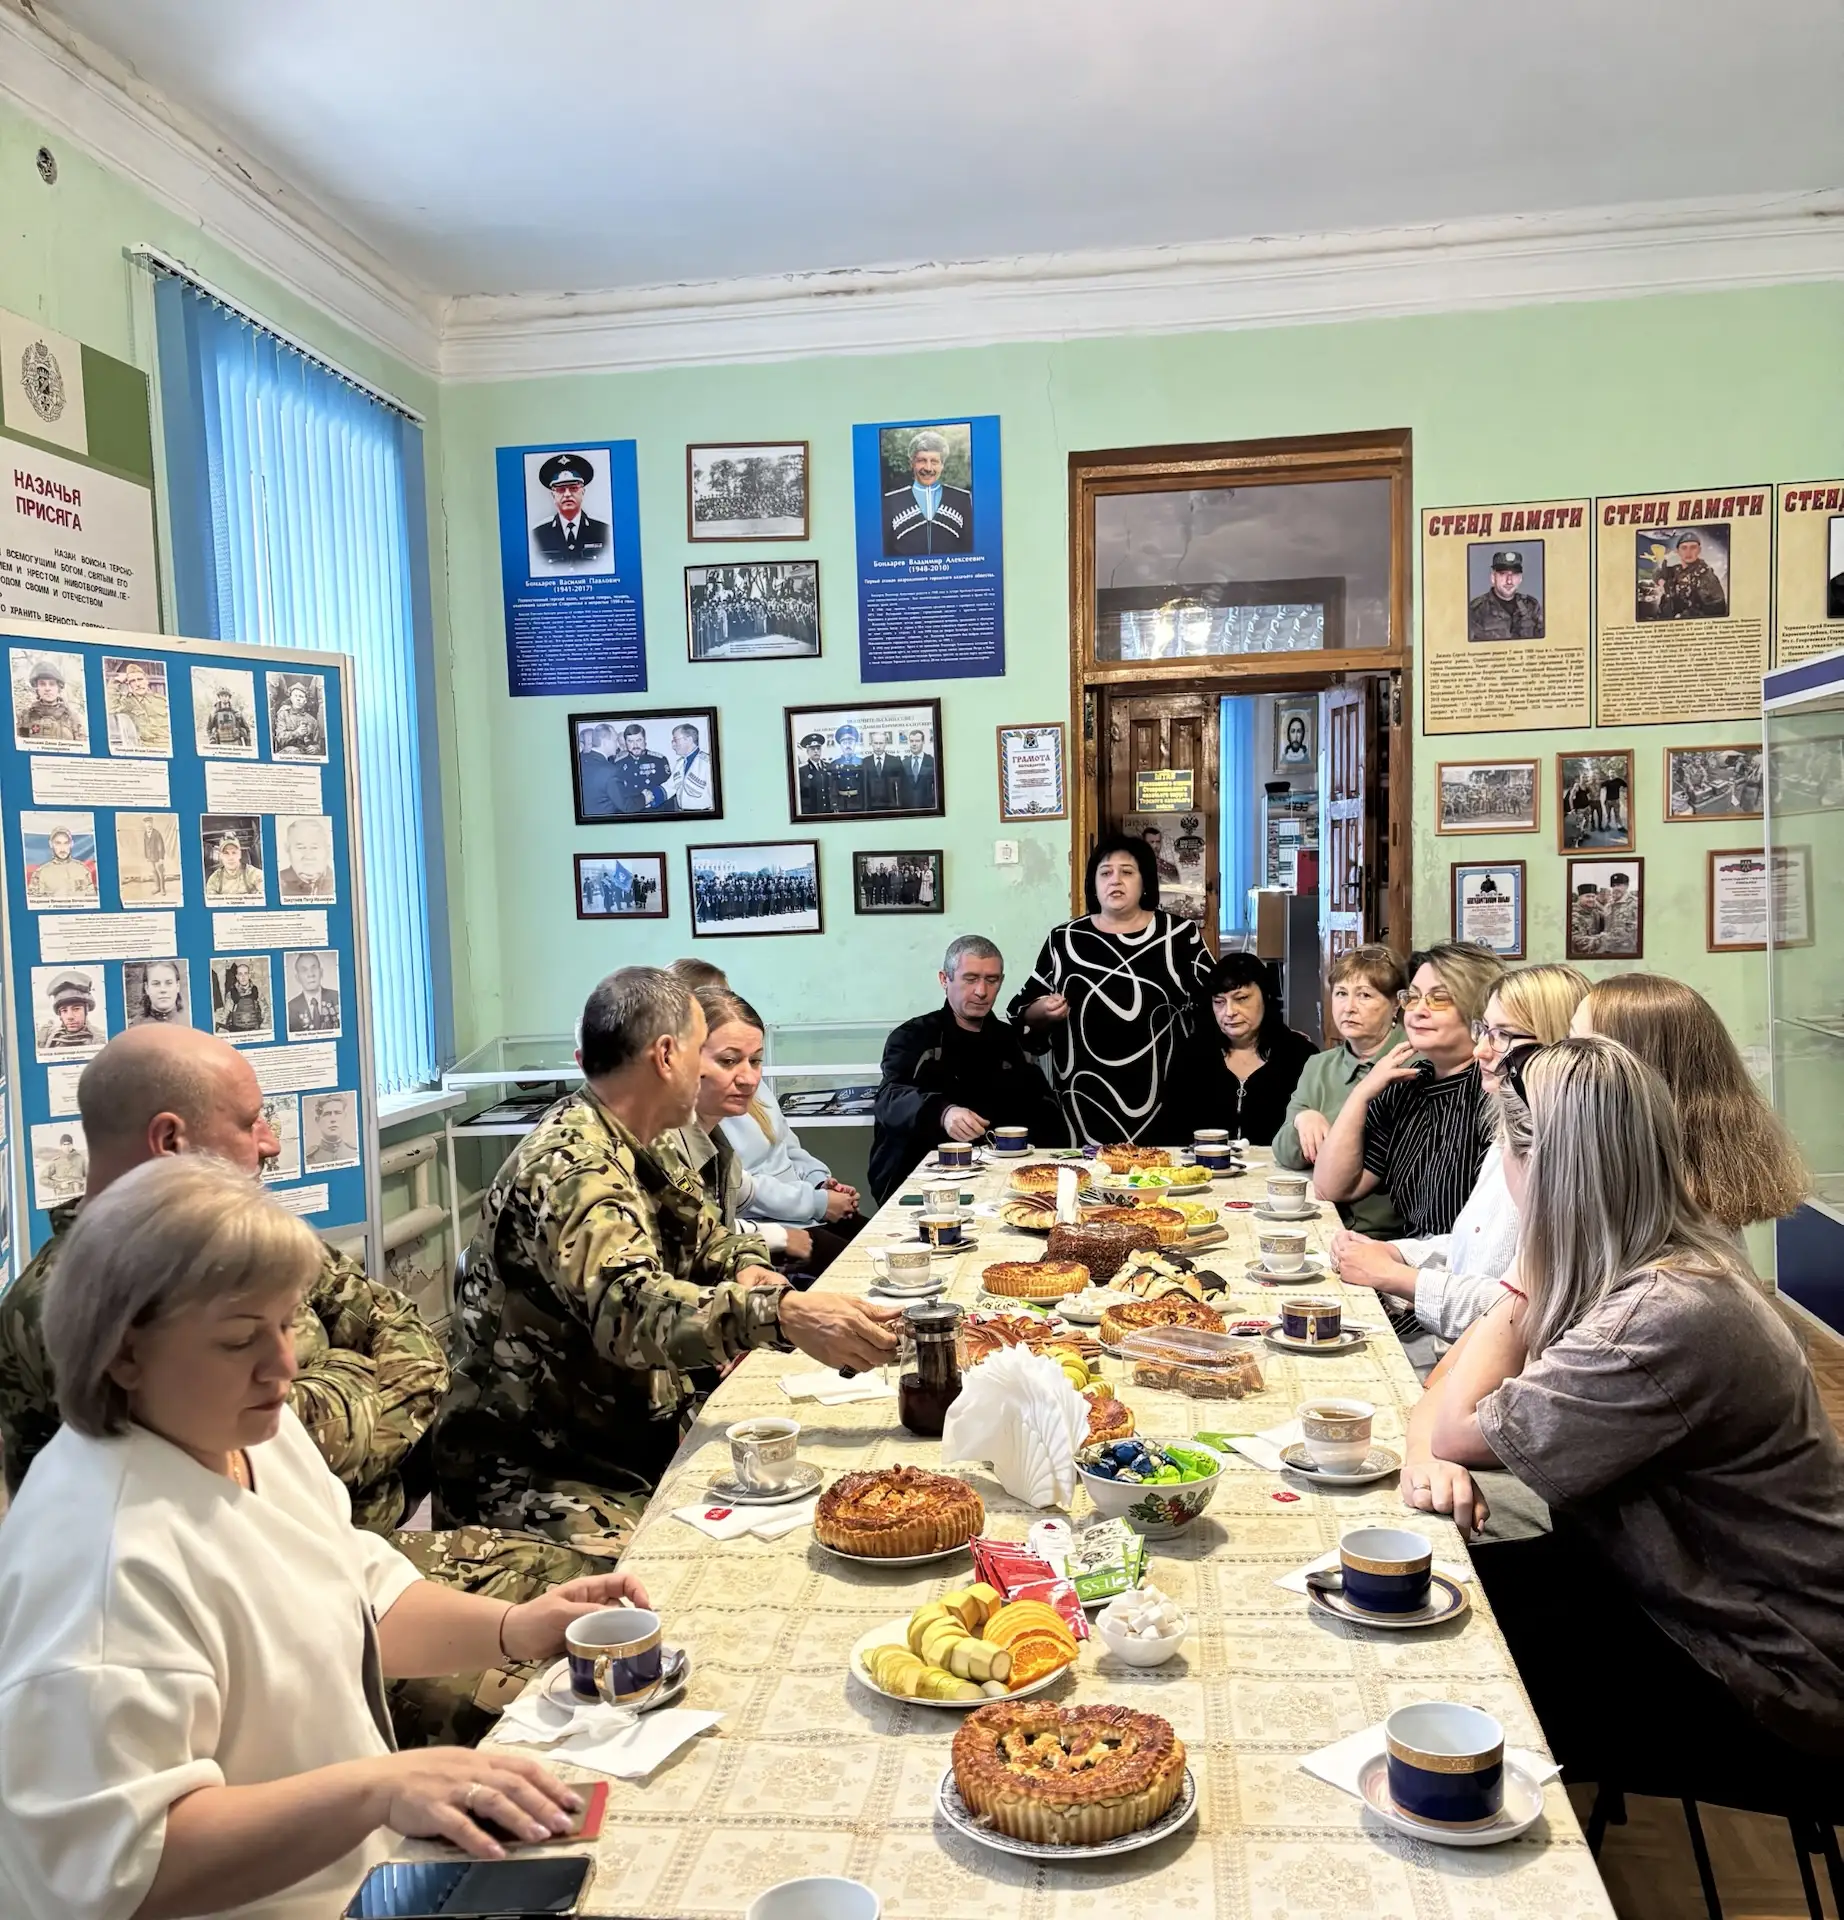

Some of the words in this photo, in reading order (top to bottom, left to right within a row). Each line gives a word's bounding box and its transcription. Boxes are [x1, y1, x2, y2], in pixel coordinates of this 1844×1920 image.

[16, 496, 82, 531] ПРИСЯГА
[1603, 501, 1670, 526] СТЕНД
[1676, 494, 1765, 521] ПАМЯТИ
[1428, 512, 1493, 537] СТЕНД
[1499, 507, 1584, 533] ПАМЯТИ
[81, 555, 106, 570] ВОЙСКА
[946, 556, 985, 564] Алексеевич
[17, 566, 22, 575] И
[908, 565, 950, 574] (1948-2010)
[88, 571, 114, 584] СВЯТЫМ
[117, 578, 128, 588] ЕГО
[0, 576, 21, 588] ОДОМ
[25, 582, 50, 595] СВОИМ
[53, 588, 58, 597] И
[62, 591, 103, 608] ОТЕЧЕСТВОМ
[553, 585, 593, 593] (1941-2017)
[10, 606, 42, 620] ХРАНИТЬ
[45, 613, 78, 626] ВЕРНОСТЬ
[1012, 753, 1051, 764] ГРАМОТА
